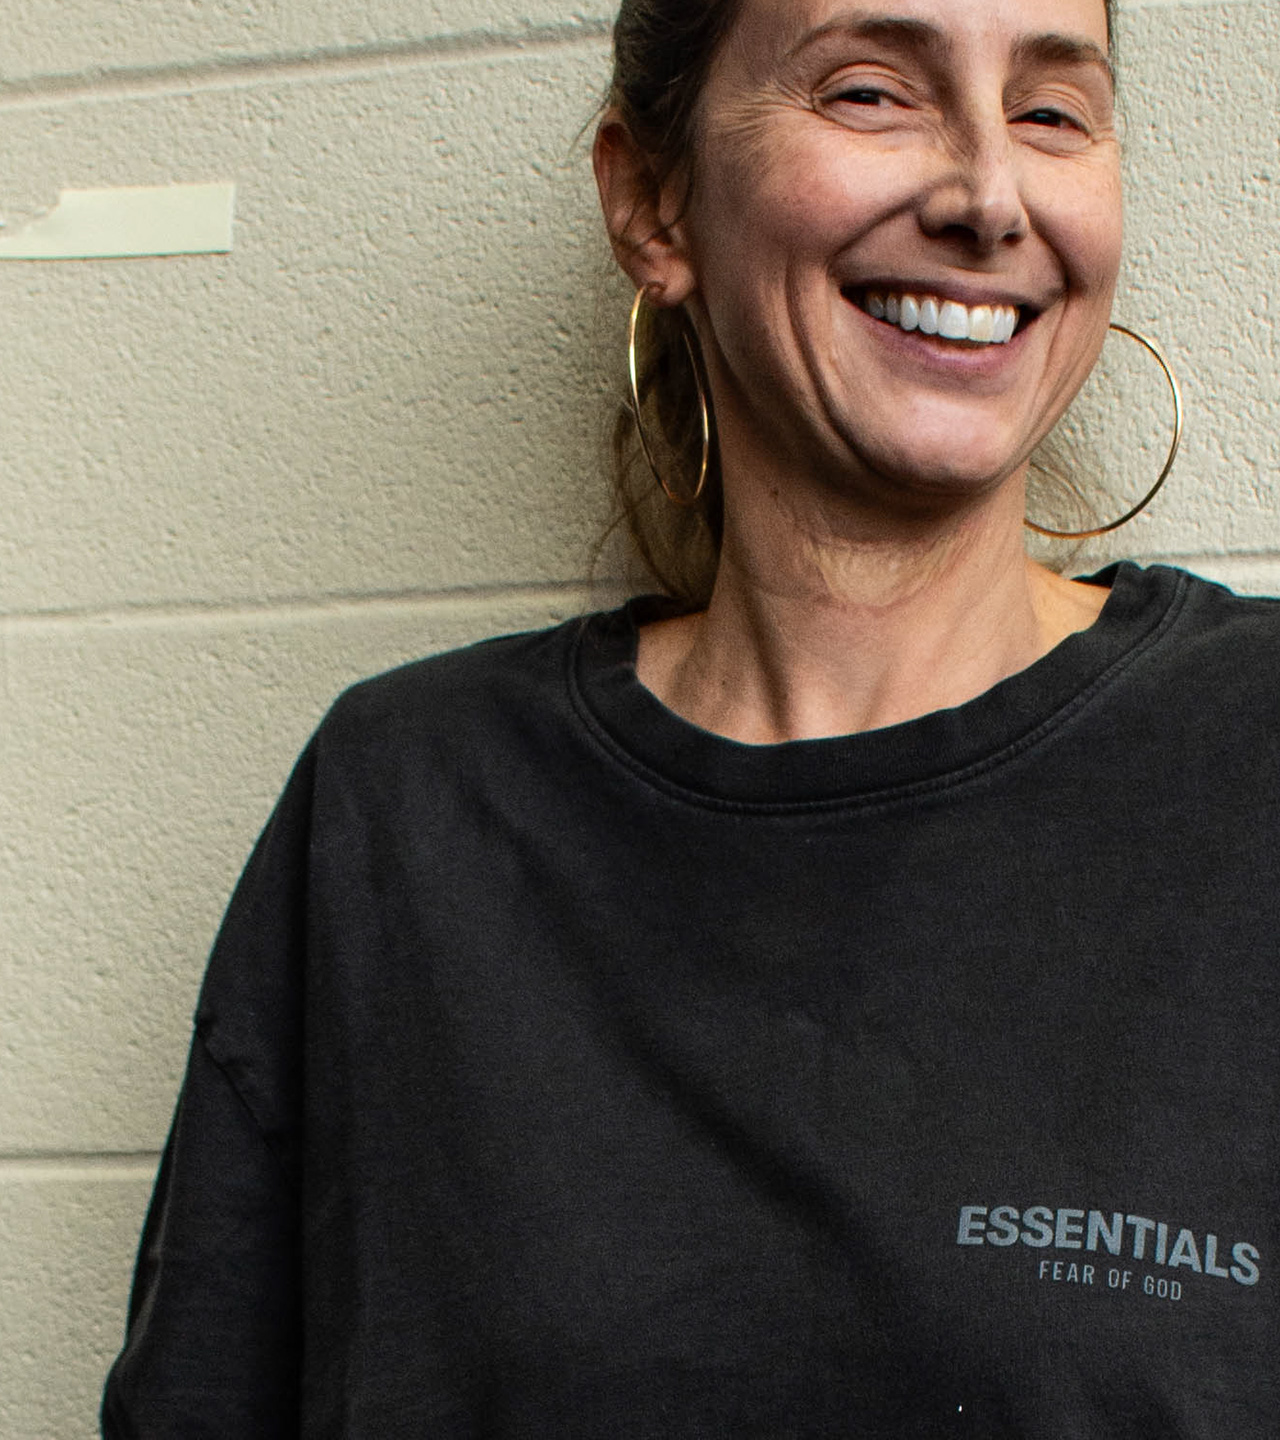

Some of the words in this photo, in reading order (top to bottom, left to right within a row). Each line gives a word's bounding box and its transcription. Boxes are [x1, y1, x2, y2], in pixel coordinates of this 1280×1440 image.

[956, 1205, 1261, 1287] ESSENTIALS
[1038, 1259, 1095, 1285] FEAR
[1108, 1268, 1134, 1290] OF
[1143, 1274, 1183, 1301] GOD
